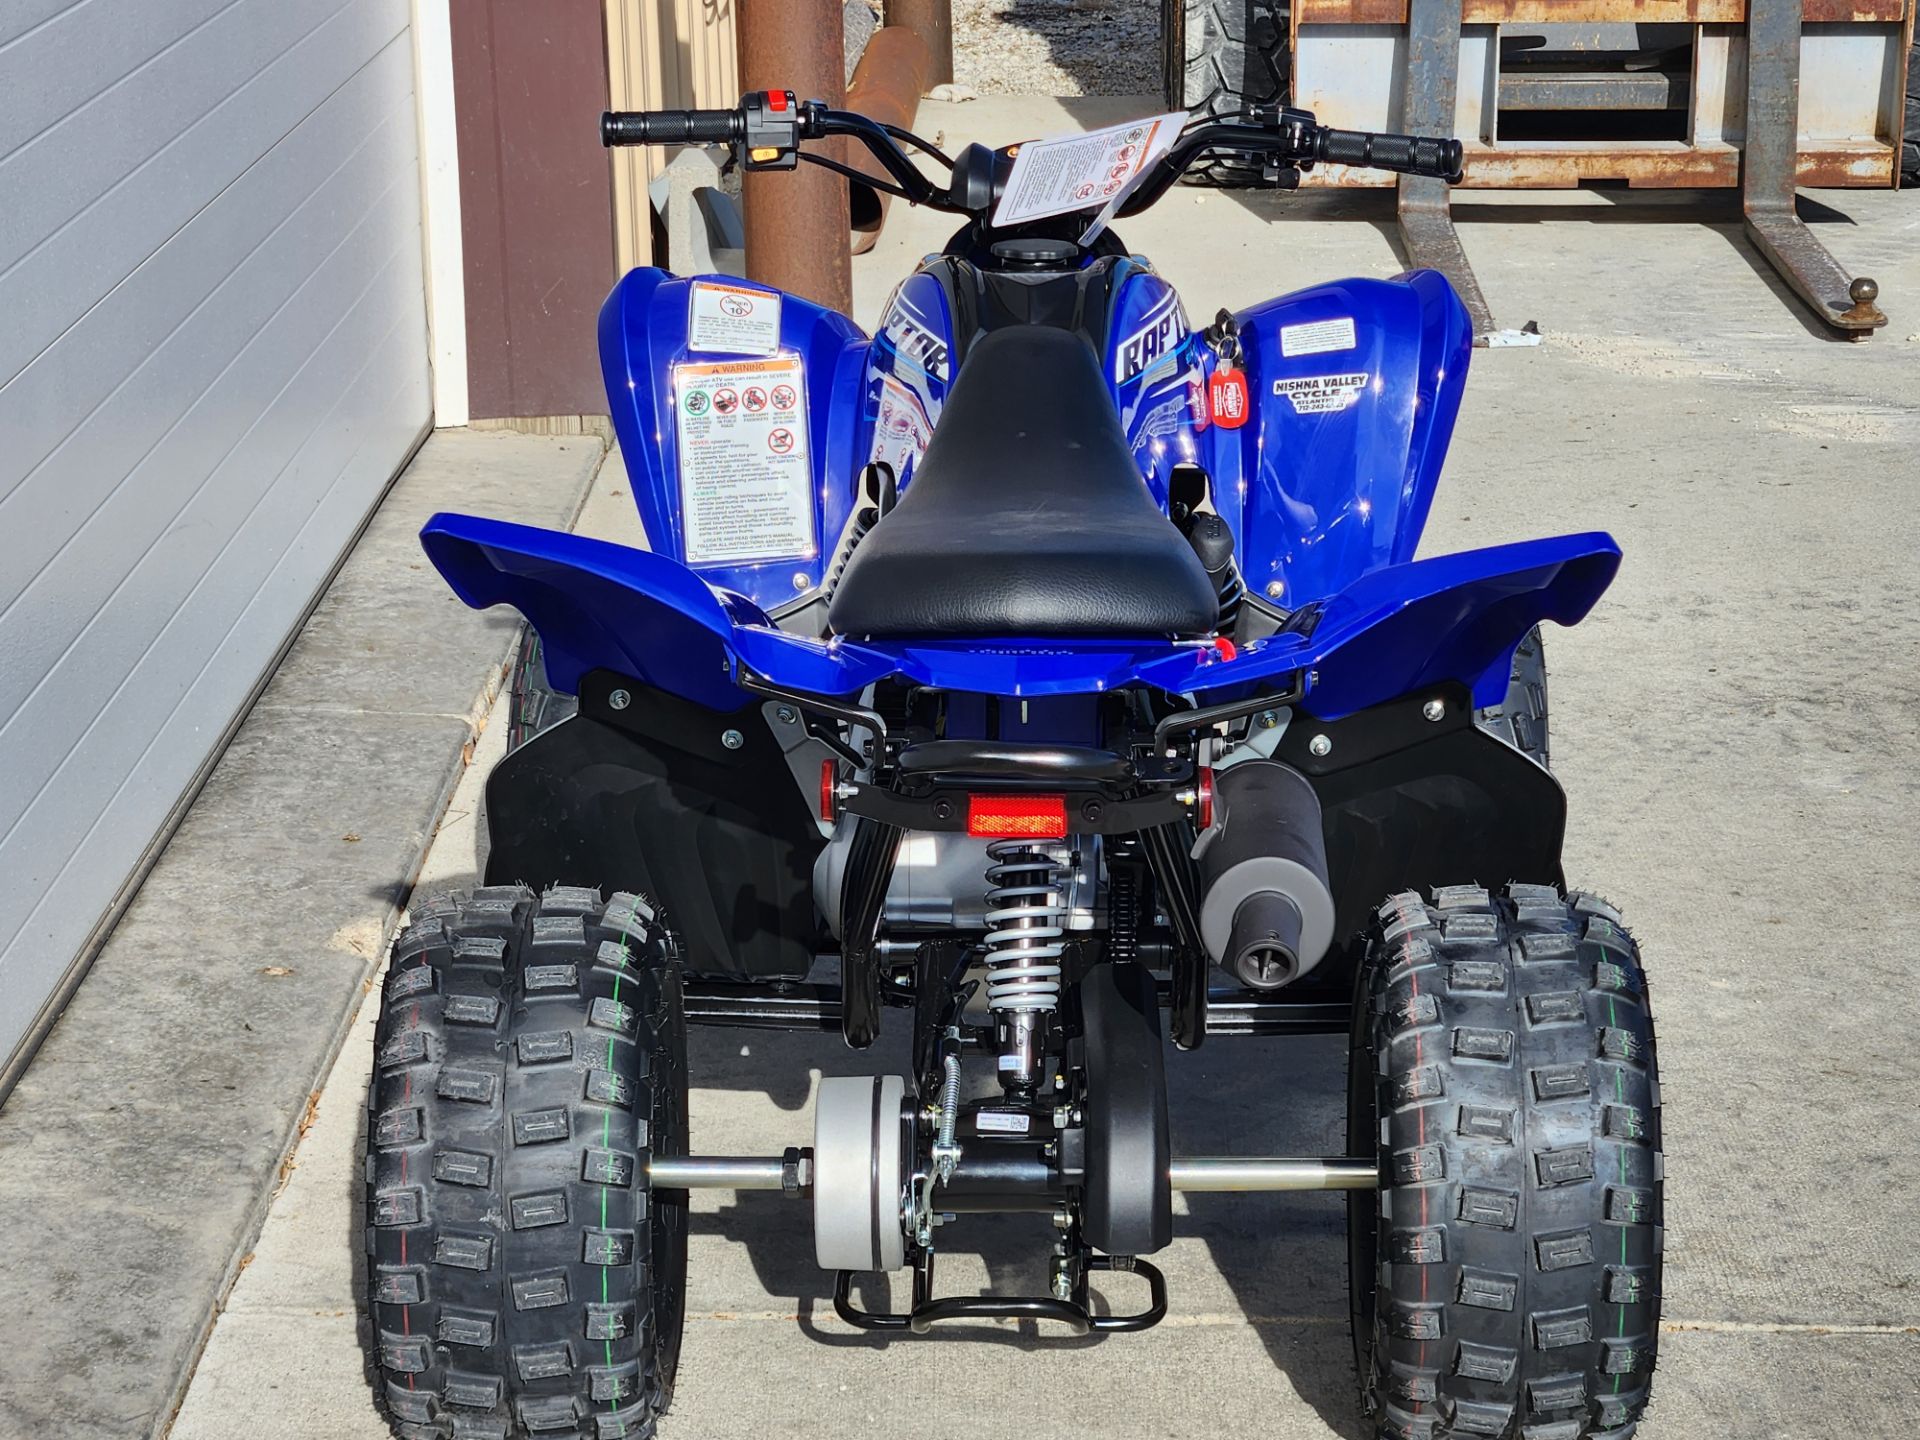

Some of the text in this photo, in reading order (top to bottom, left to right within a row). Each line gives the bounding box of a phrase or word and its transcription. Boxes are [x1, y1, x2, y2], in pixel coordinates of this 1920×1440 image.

[729, 307, 743, 315] 10
[722, 363, 765, 374] WARNING
[1276, 375, 1366, 392] NISHNA VALLEY
[1291, 389, 1341, 399] CYCLE
